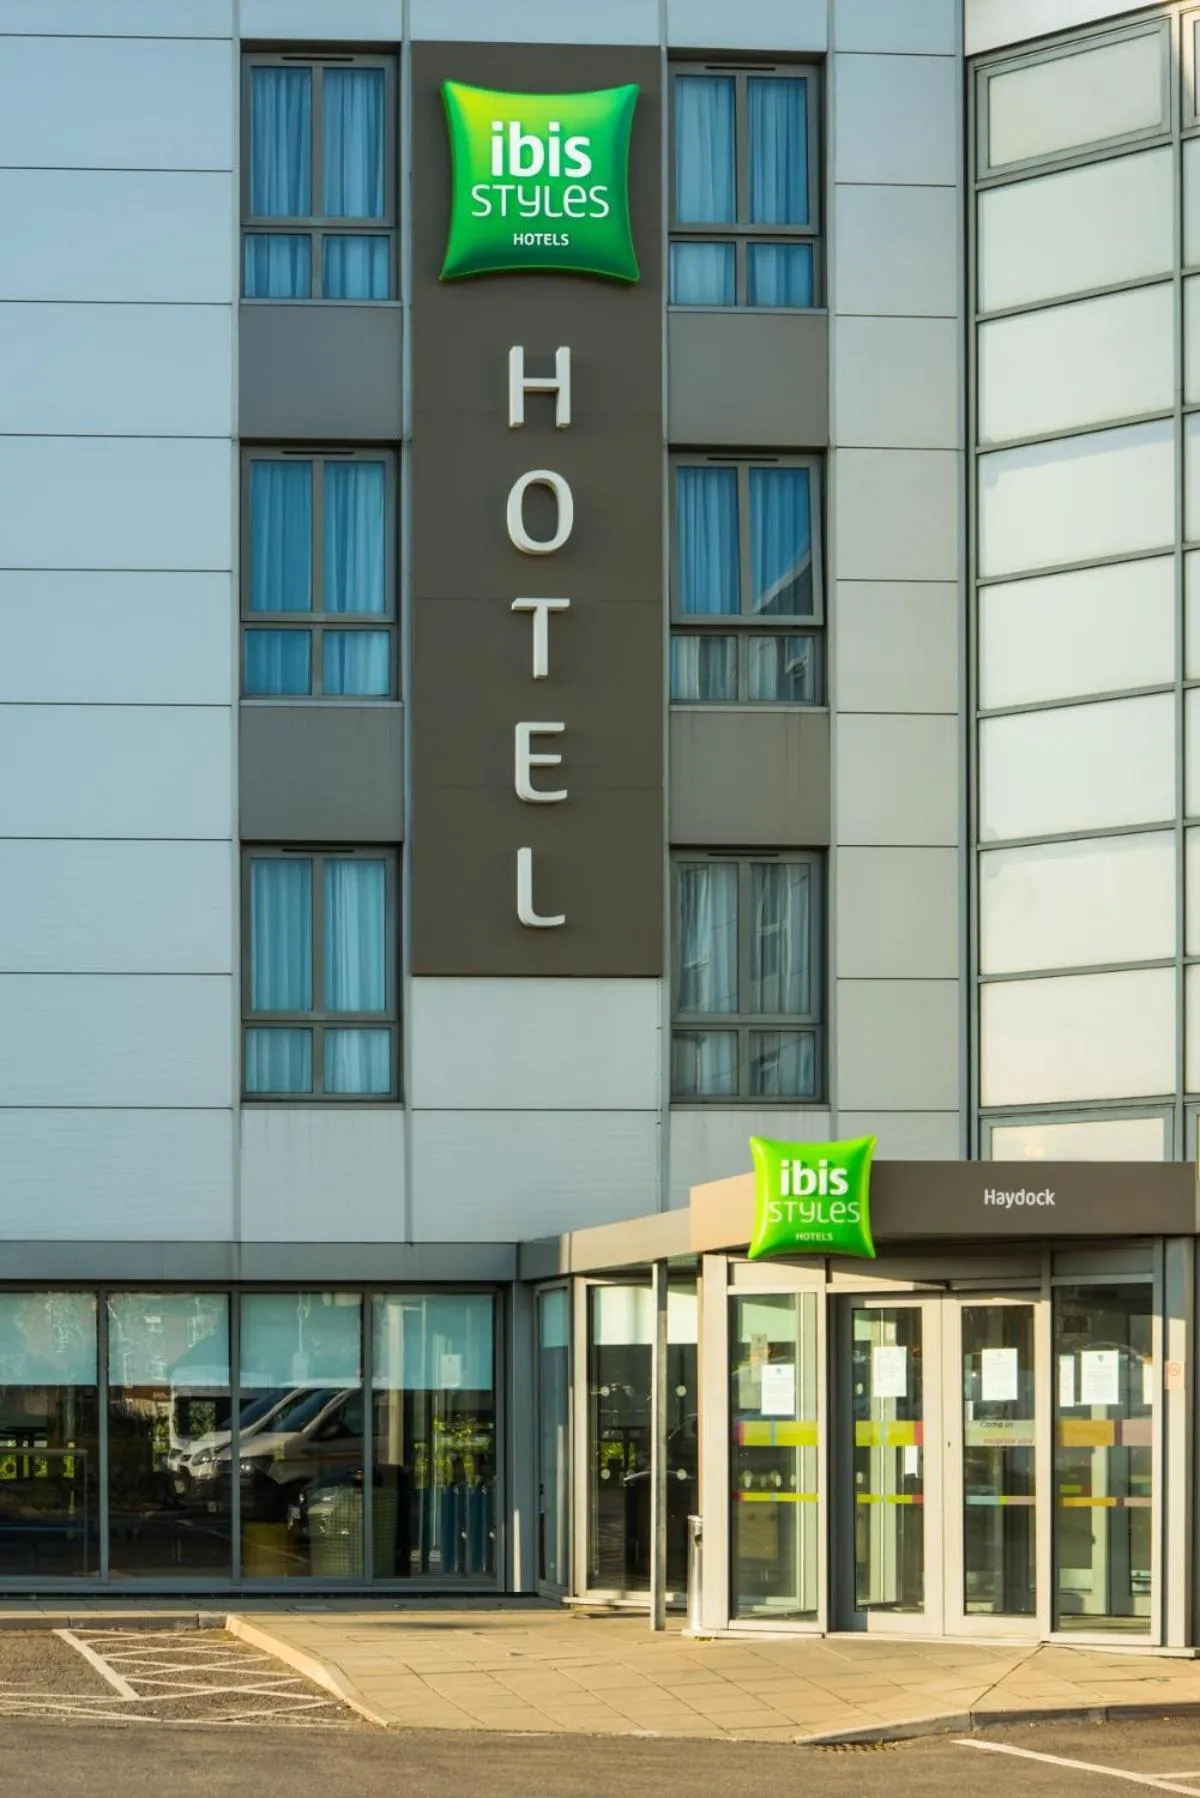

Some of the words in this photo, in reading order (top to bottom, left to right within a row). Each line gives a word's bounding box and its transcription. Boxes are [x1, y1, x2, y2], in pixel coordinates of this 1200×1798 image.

[491, 120, 592, 178] ibis
[513, 233, 569, 246] HOTELS
[506, 345, 574, 928] HOTEL
[780, 1159, 849, 1196] ibis
[984, 1188, 1056, 1209] Haydock
[795, 1232, 833, 1241] HOTELS
